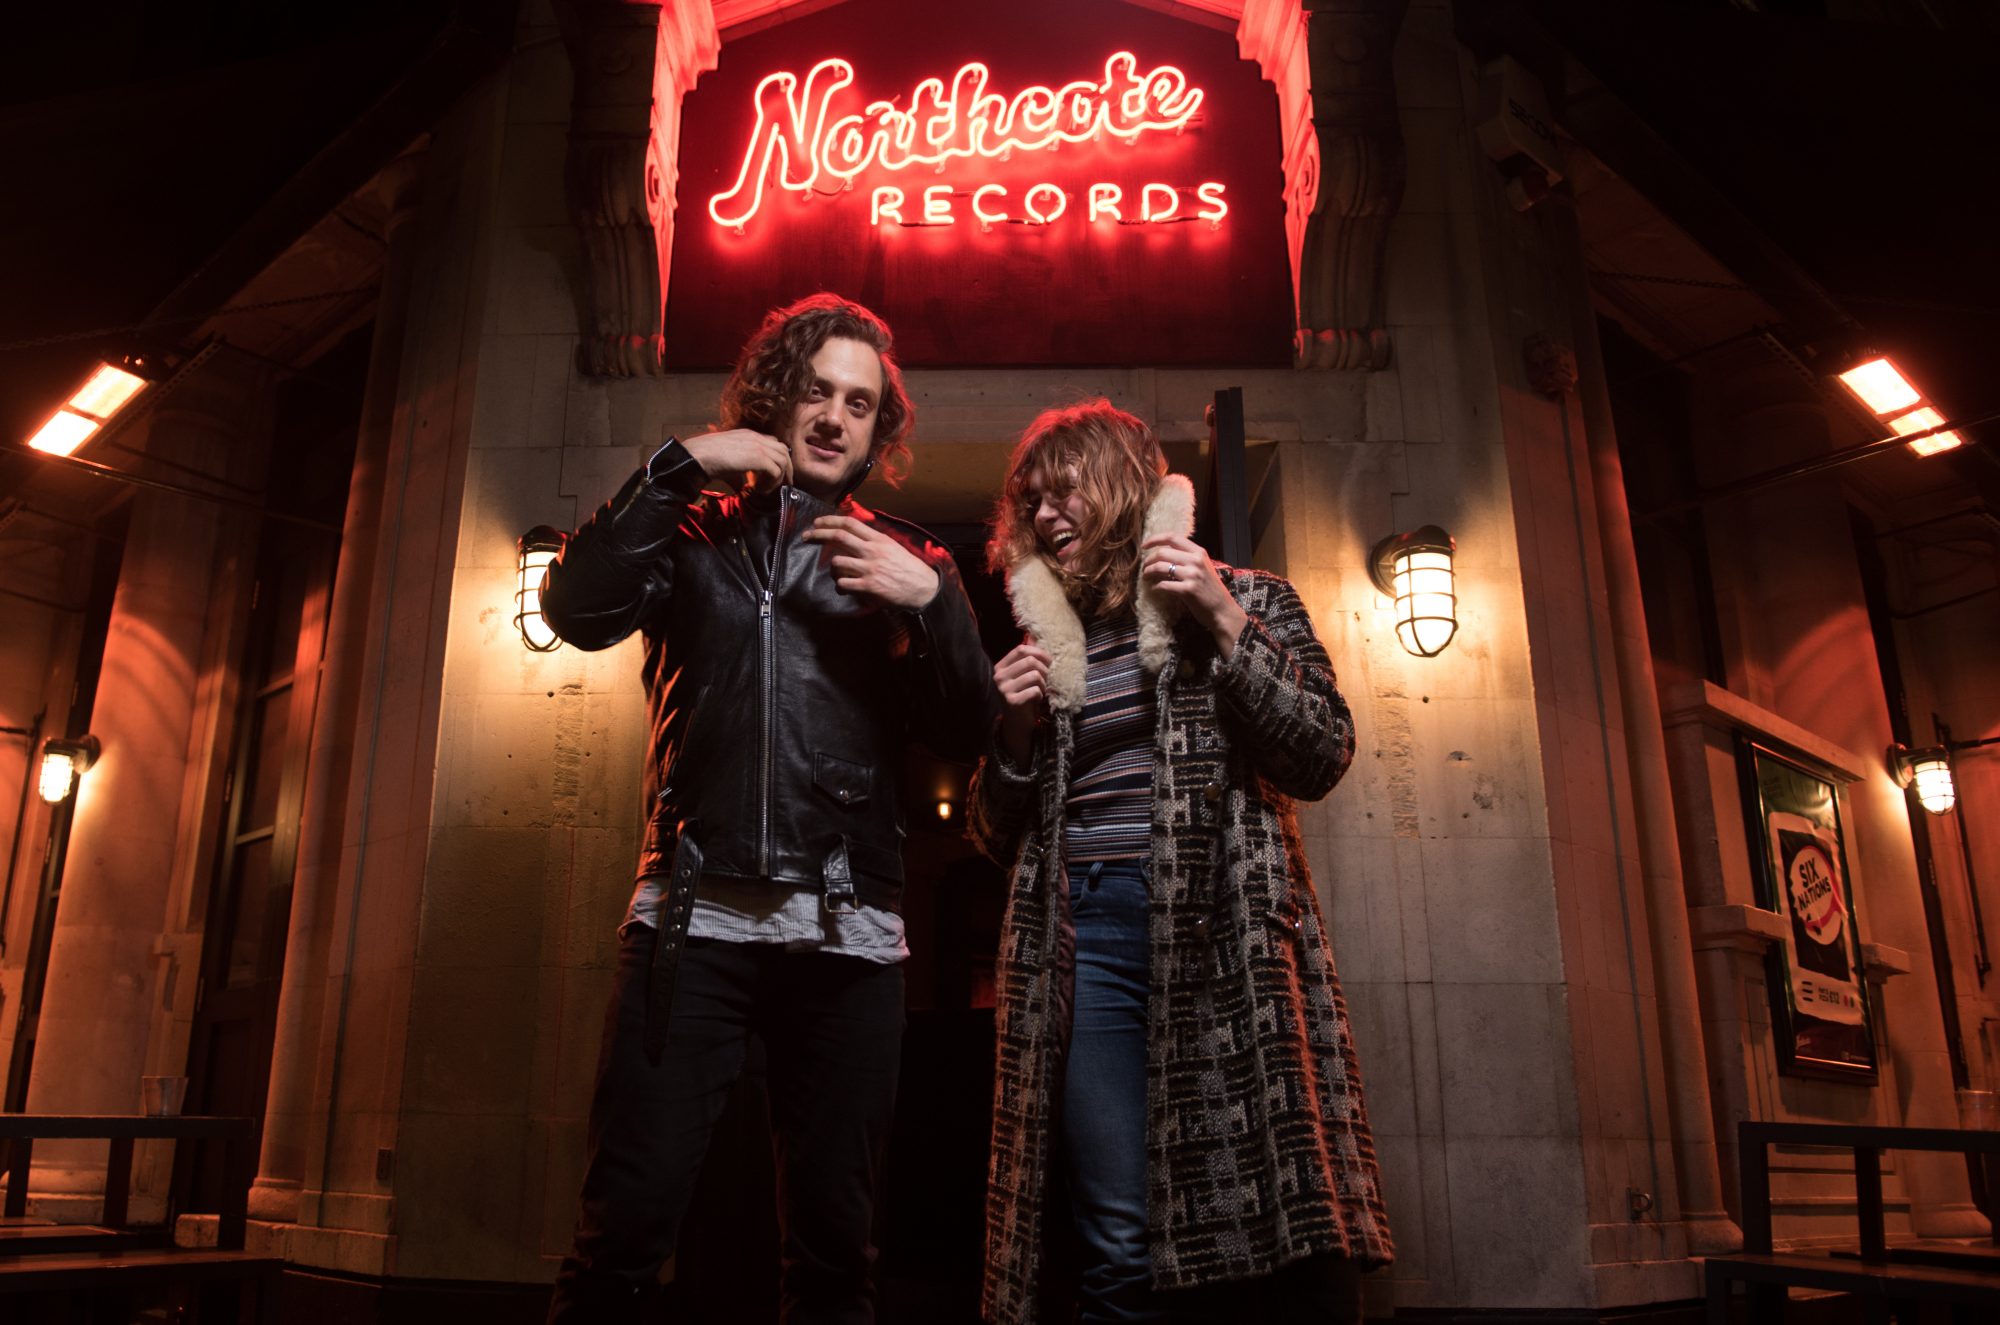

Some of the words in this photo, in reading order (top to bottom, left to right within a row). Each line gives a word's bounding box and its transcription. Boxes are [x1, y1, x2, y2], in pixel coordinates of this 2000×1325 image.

[709, 51, 1204, 227] Northcote
[871, 183, 1229, 226] RECORDS
[1799, 857, 1819, 888] SIX
[1797, 877, 1831, 911] NATIONS
